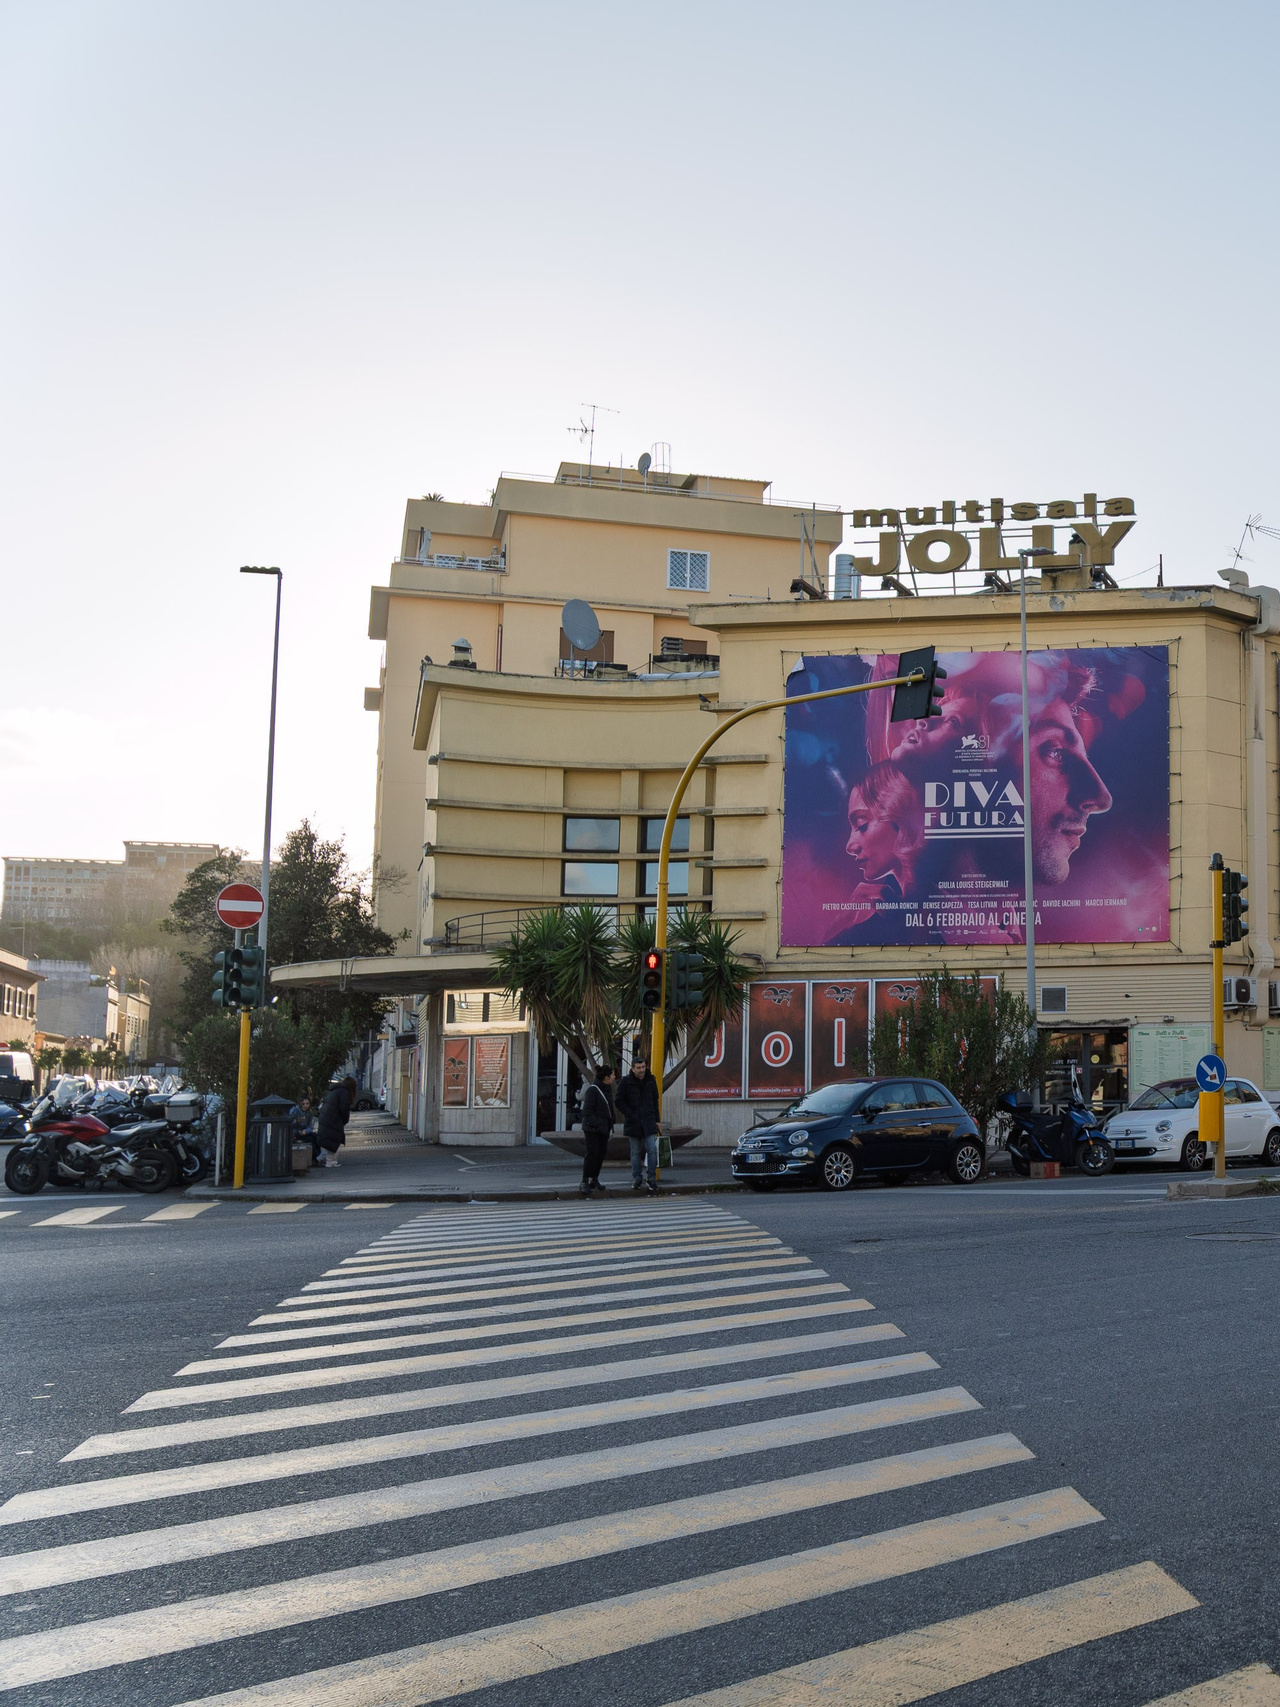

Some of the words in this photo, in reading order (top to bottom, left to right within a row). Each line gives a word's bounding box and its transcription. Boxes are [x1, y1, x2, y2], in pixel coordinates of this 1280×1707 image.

[852, 493, 1137, 528] multisala
[852, 520, 1137, 576] JOLLY
[925, 780, 1025, 808] DIVA
[924, 810, 1025, 827] FUTURA
[938, 881, 956, 889] GIULIA
[956, 881, 974, 889] LOUISE
[975, 880, 1009, 889] STEIGERWALT
[822, 903, 840, 911] PIETRO
[840, 902, 872, 910] CASTELLITTO
[875, 902, 899, 910] BARBARA
[899, 902, 919, 910] RONCHI
[922, 902, 941, 910] DENISE
[941, 901, 964, 910] CAPEZZA
[967, 901, 980, 909] TESA
[980, 901, 998, 909] LITVAN
[1042, 900, 1061, 908] DAVIDE
[1061, 899, 1081, 907] IACHINI
[1085, 899, 1103, 907] MARCO
[905, 913, 924, 927] DAL
[927, 913, 934, 927] 6
[936, 912, 985, 927] FEBBRAIO
[988, 912, 1000, 926] AL
[1003, 911, 1042, 926] CINEA
